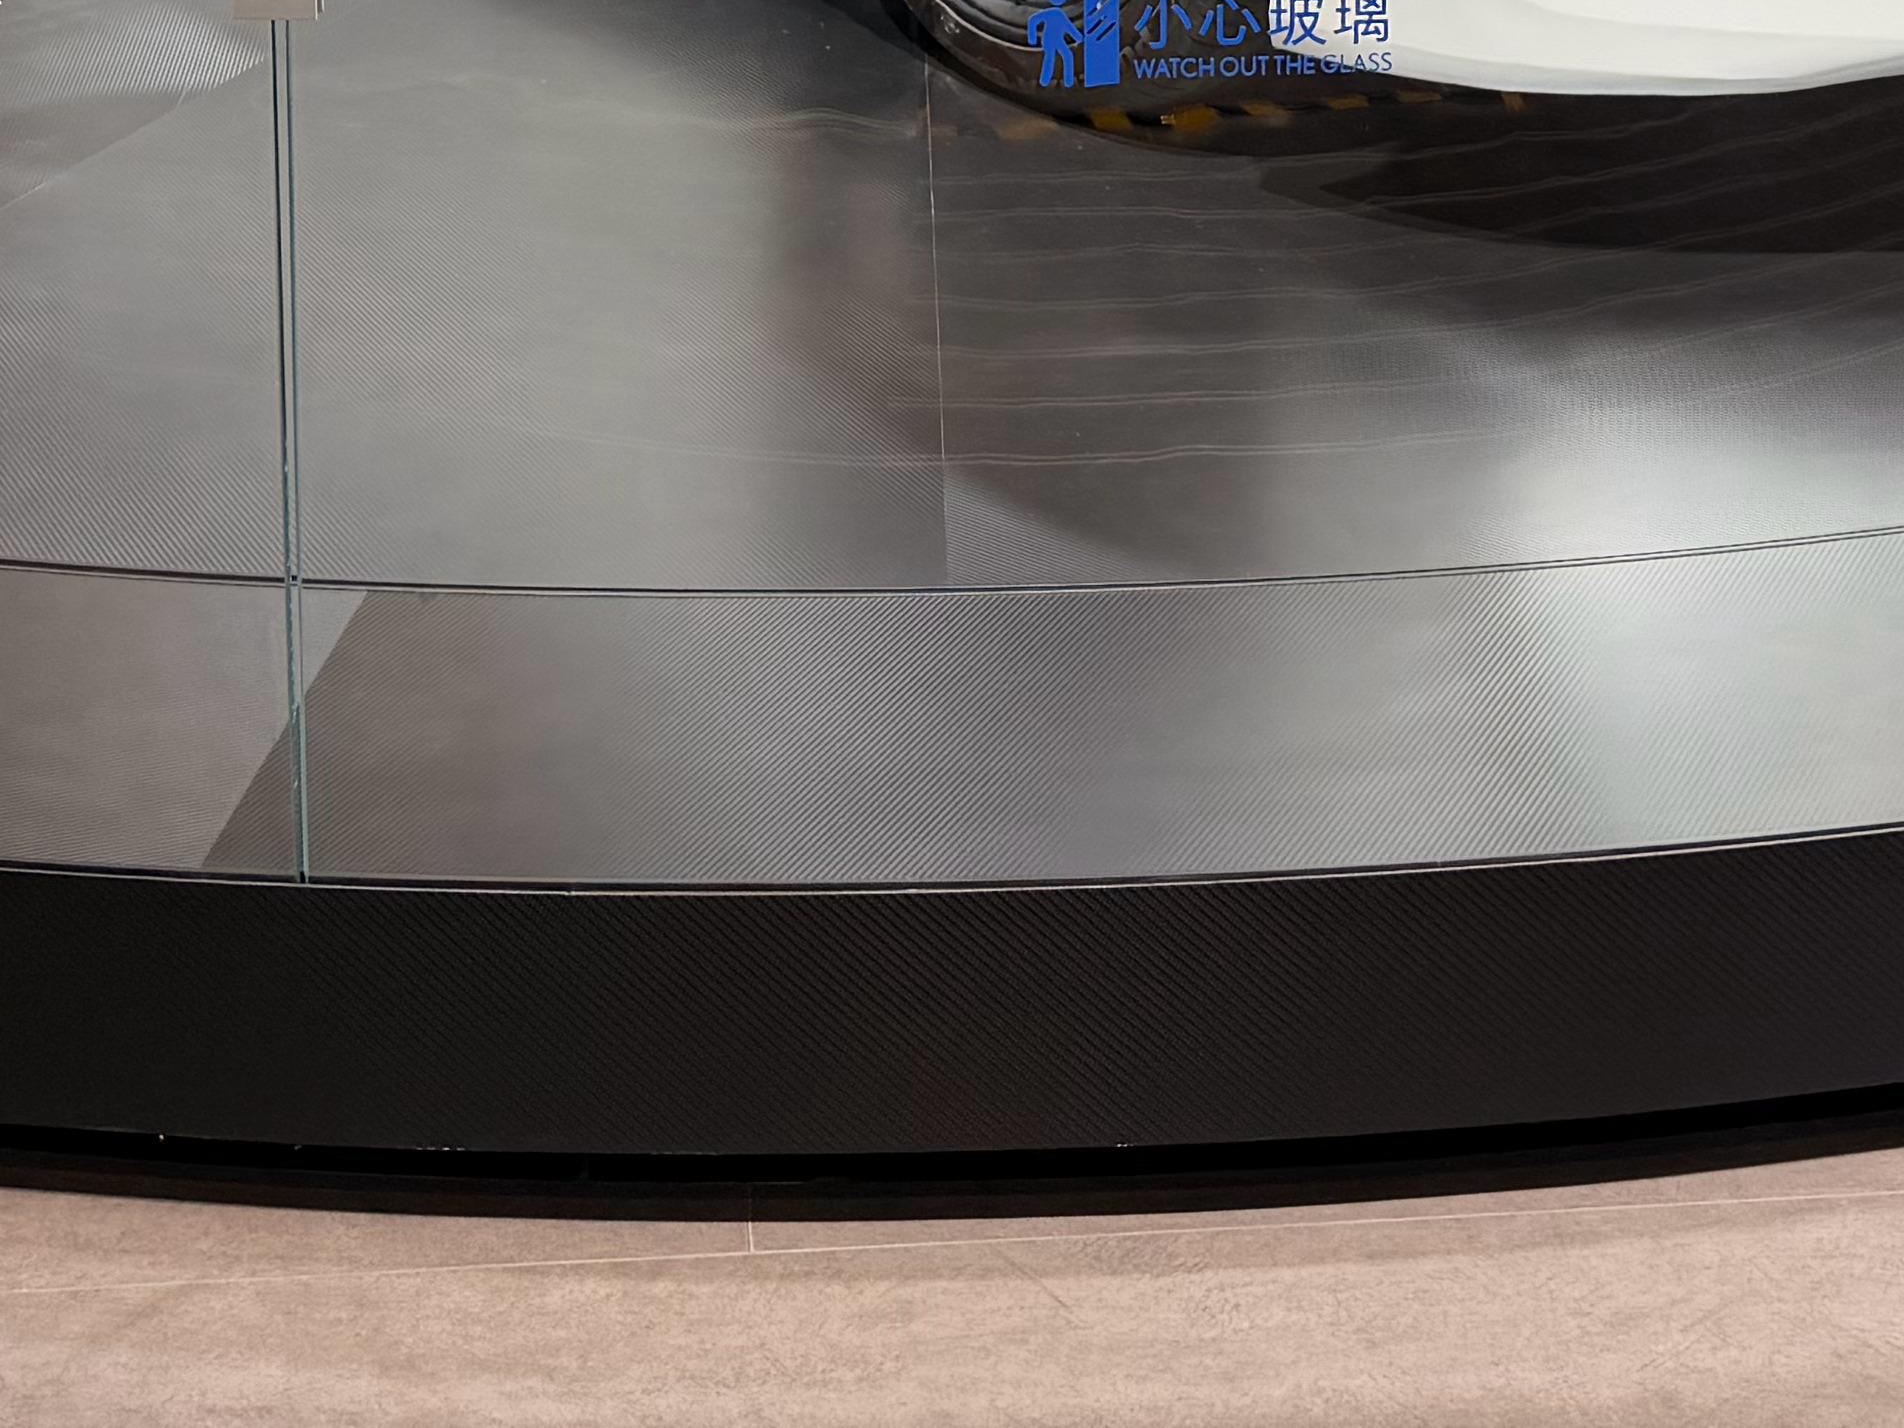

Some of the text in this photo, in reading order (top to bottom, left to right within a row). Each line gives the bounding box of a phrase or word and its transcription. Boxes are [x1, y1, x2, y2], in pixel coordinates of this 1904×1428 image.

[1133, 52, 1393, 79] WATCH OUT THE GLASS
